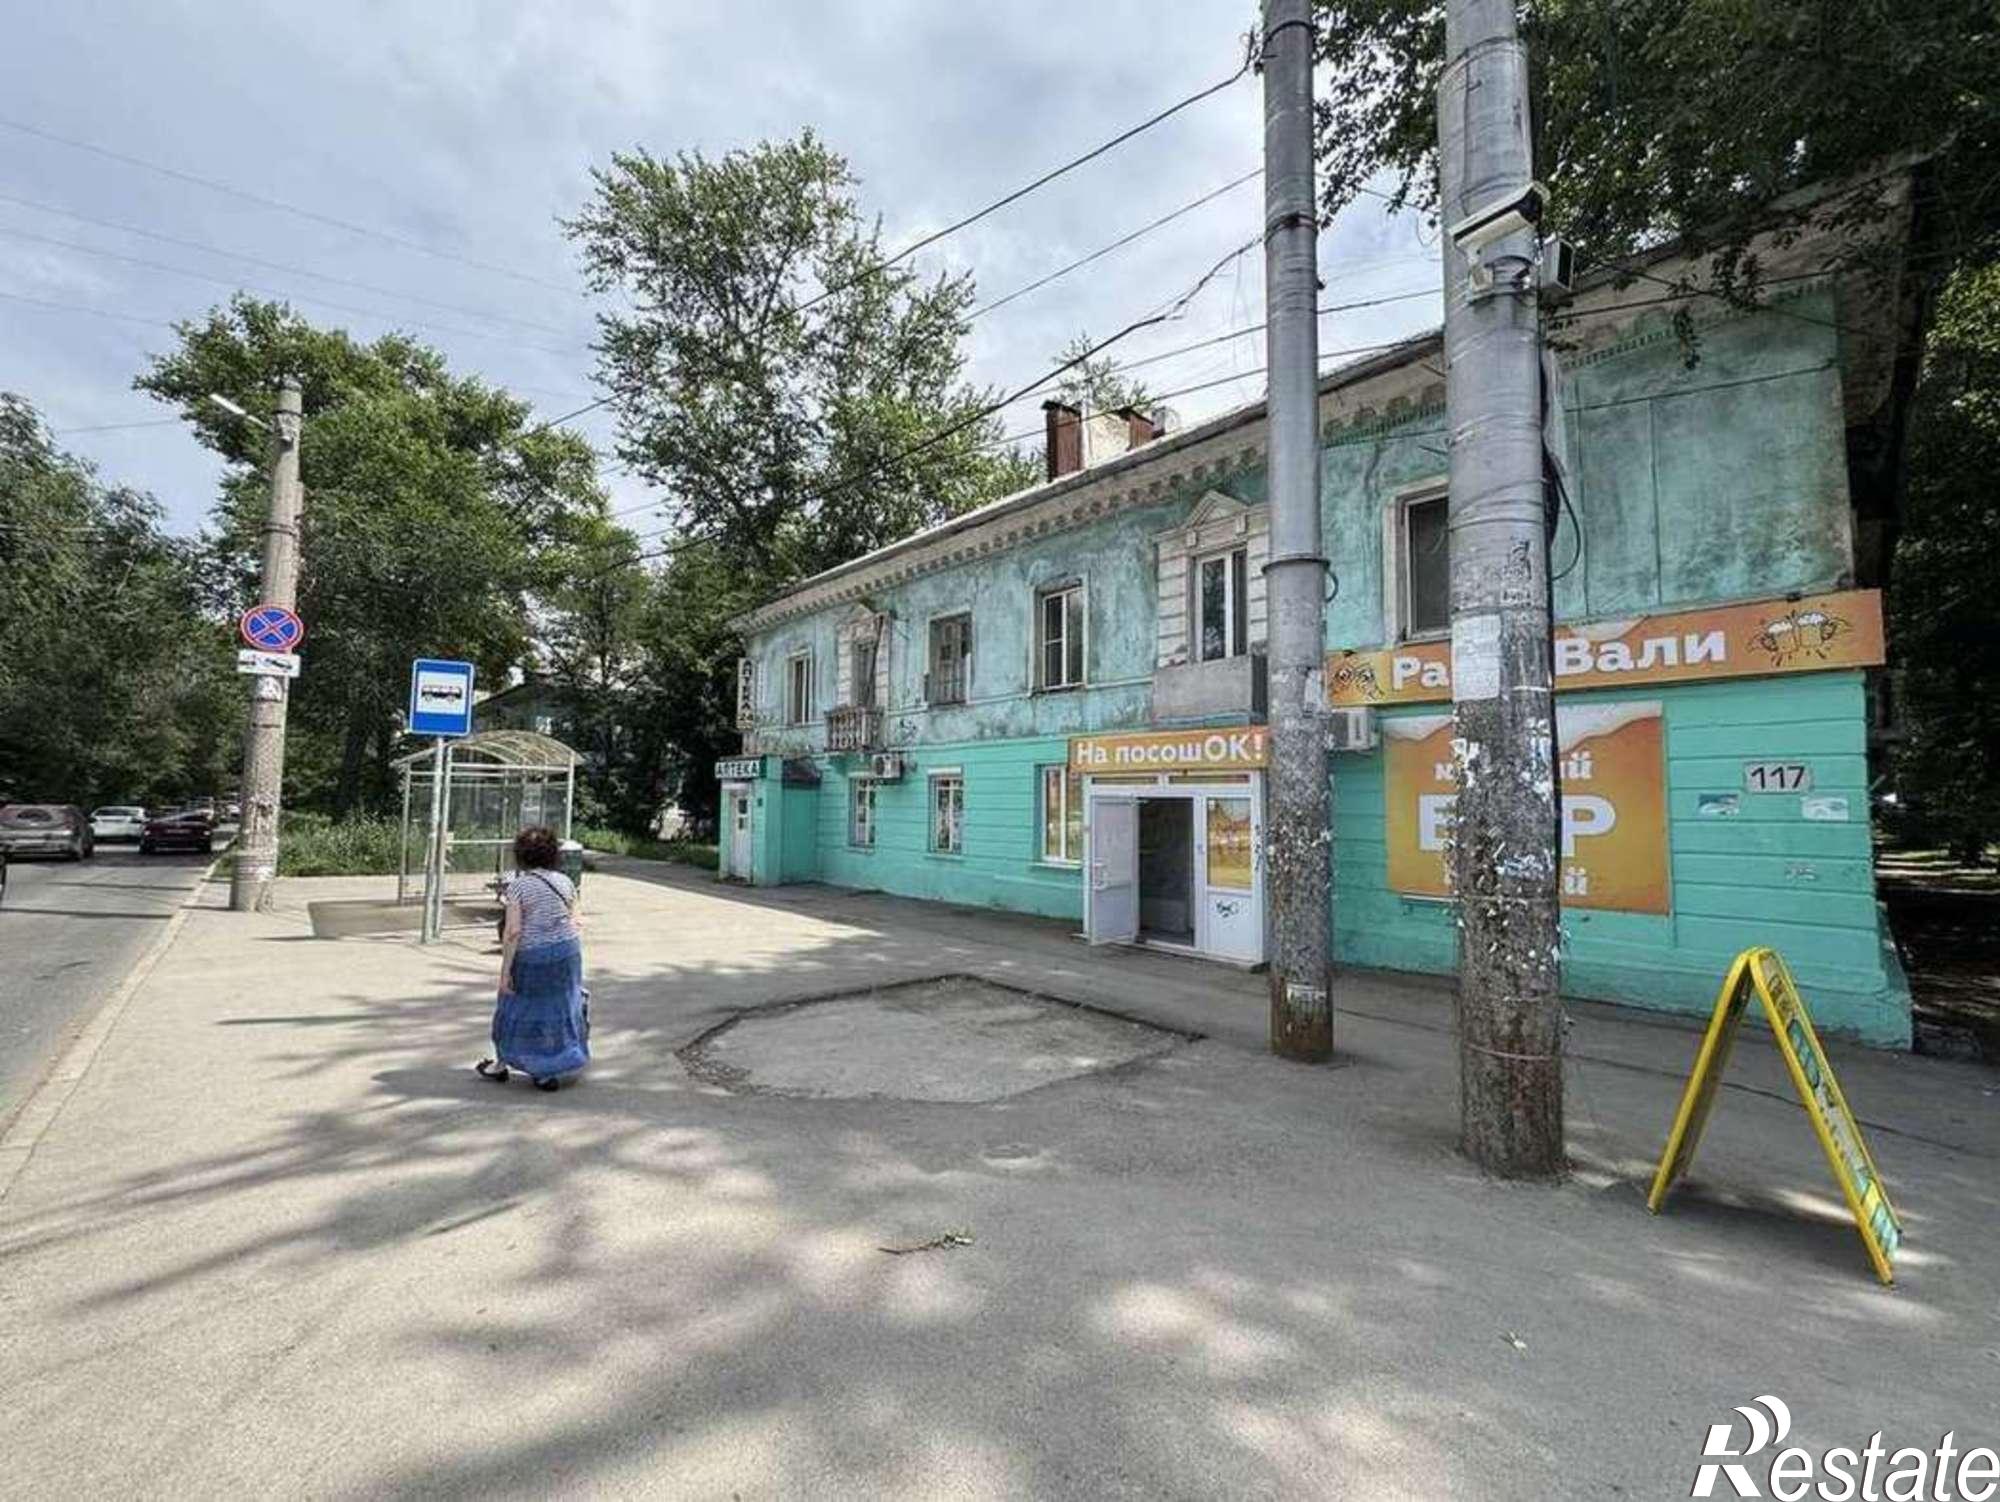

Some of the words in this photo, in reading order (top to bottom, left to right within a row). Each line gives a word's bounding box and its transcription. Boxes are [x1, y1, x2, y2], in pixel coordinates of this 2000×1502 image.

[1077, 742, 1108, 764] На
[1114, 733, 1263, 764] посошОК!
[1752, 766, 1805, 789] 117
